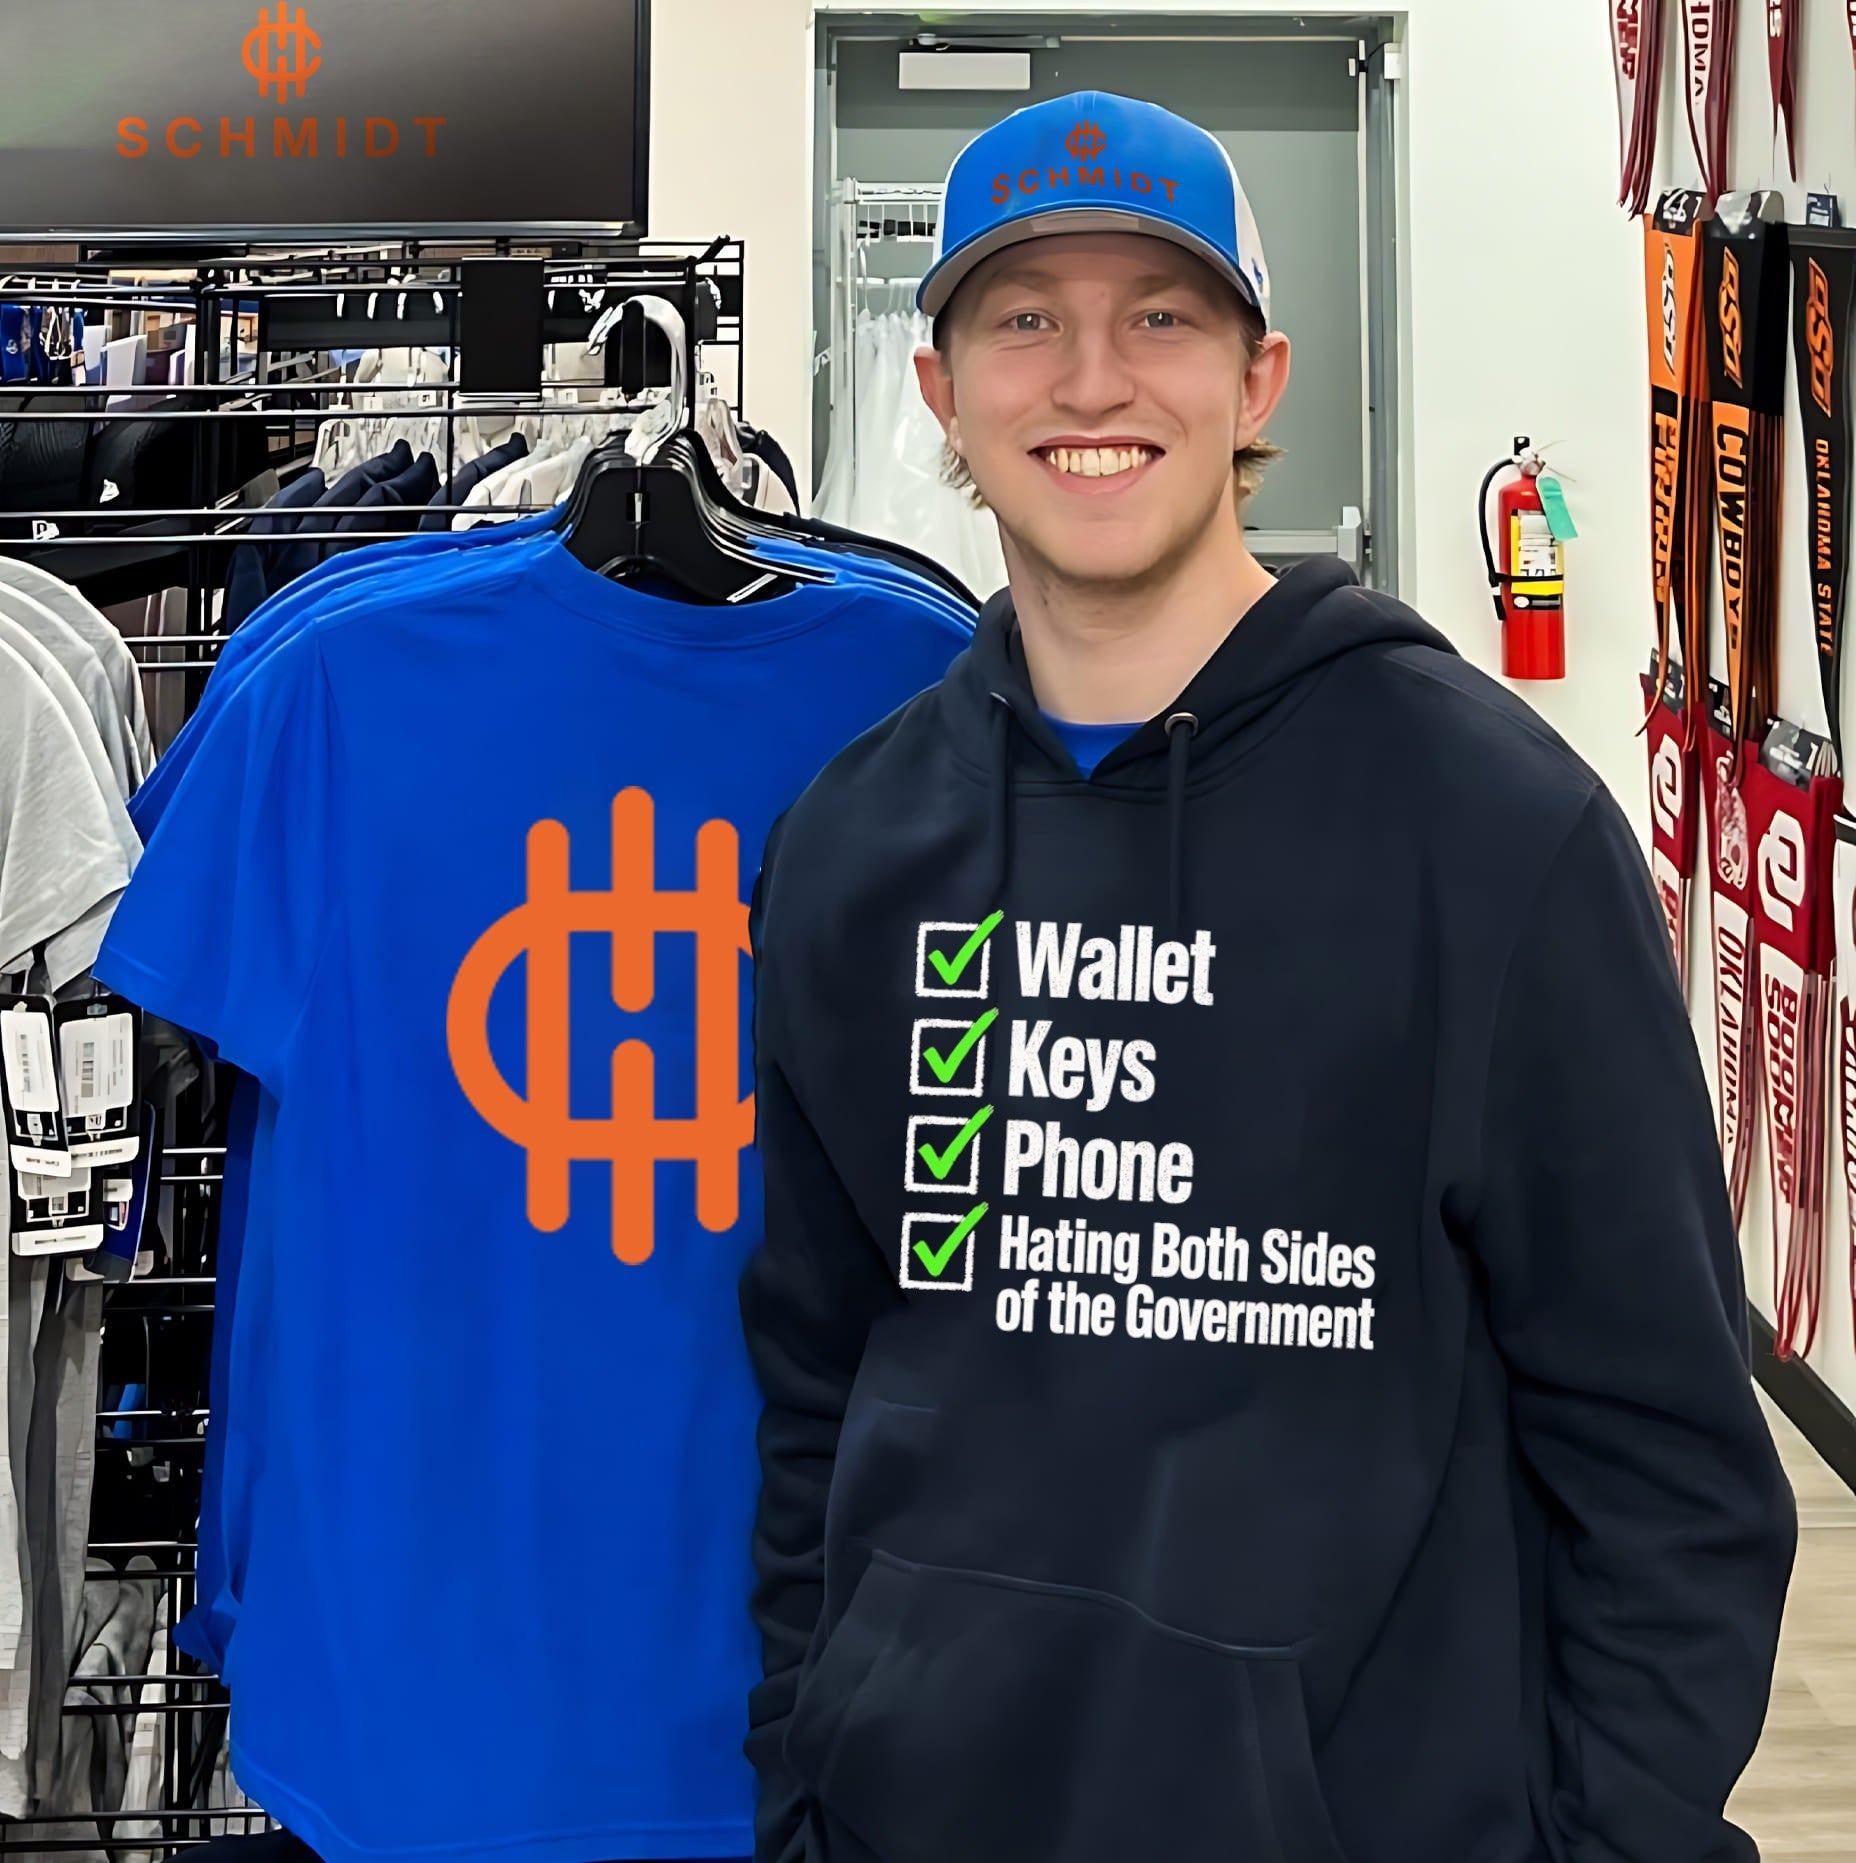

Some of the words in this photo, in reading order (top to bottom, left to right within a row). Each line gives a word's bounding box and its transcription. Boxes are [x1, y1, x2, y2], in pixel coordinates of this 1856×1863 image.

[115, 116, 448, 159] SCHMIDT
[992, 167, 1179, 204] SCHMIDT
[1815, 438, 1832, 570] OKLAHOMA
[1015, 920, 1217, 1006] Wallet
[1008, 1019, 1157, 1112] Keys
[1003, 1119, 1194, 1204] Phone
[999, 1215, 1140, 1284] Hating
[1151, 1222, 1250, 1283] Both
[1260, 1228, 1376, 1289] Sides
[995, 1278, 1040, 1333] of
[1048, 1281, 1116, 1337] the
[1125, 1284, 1376, 1350] Government
